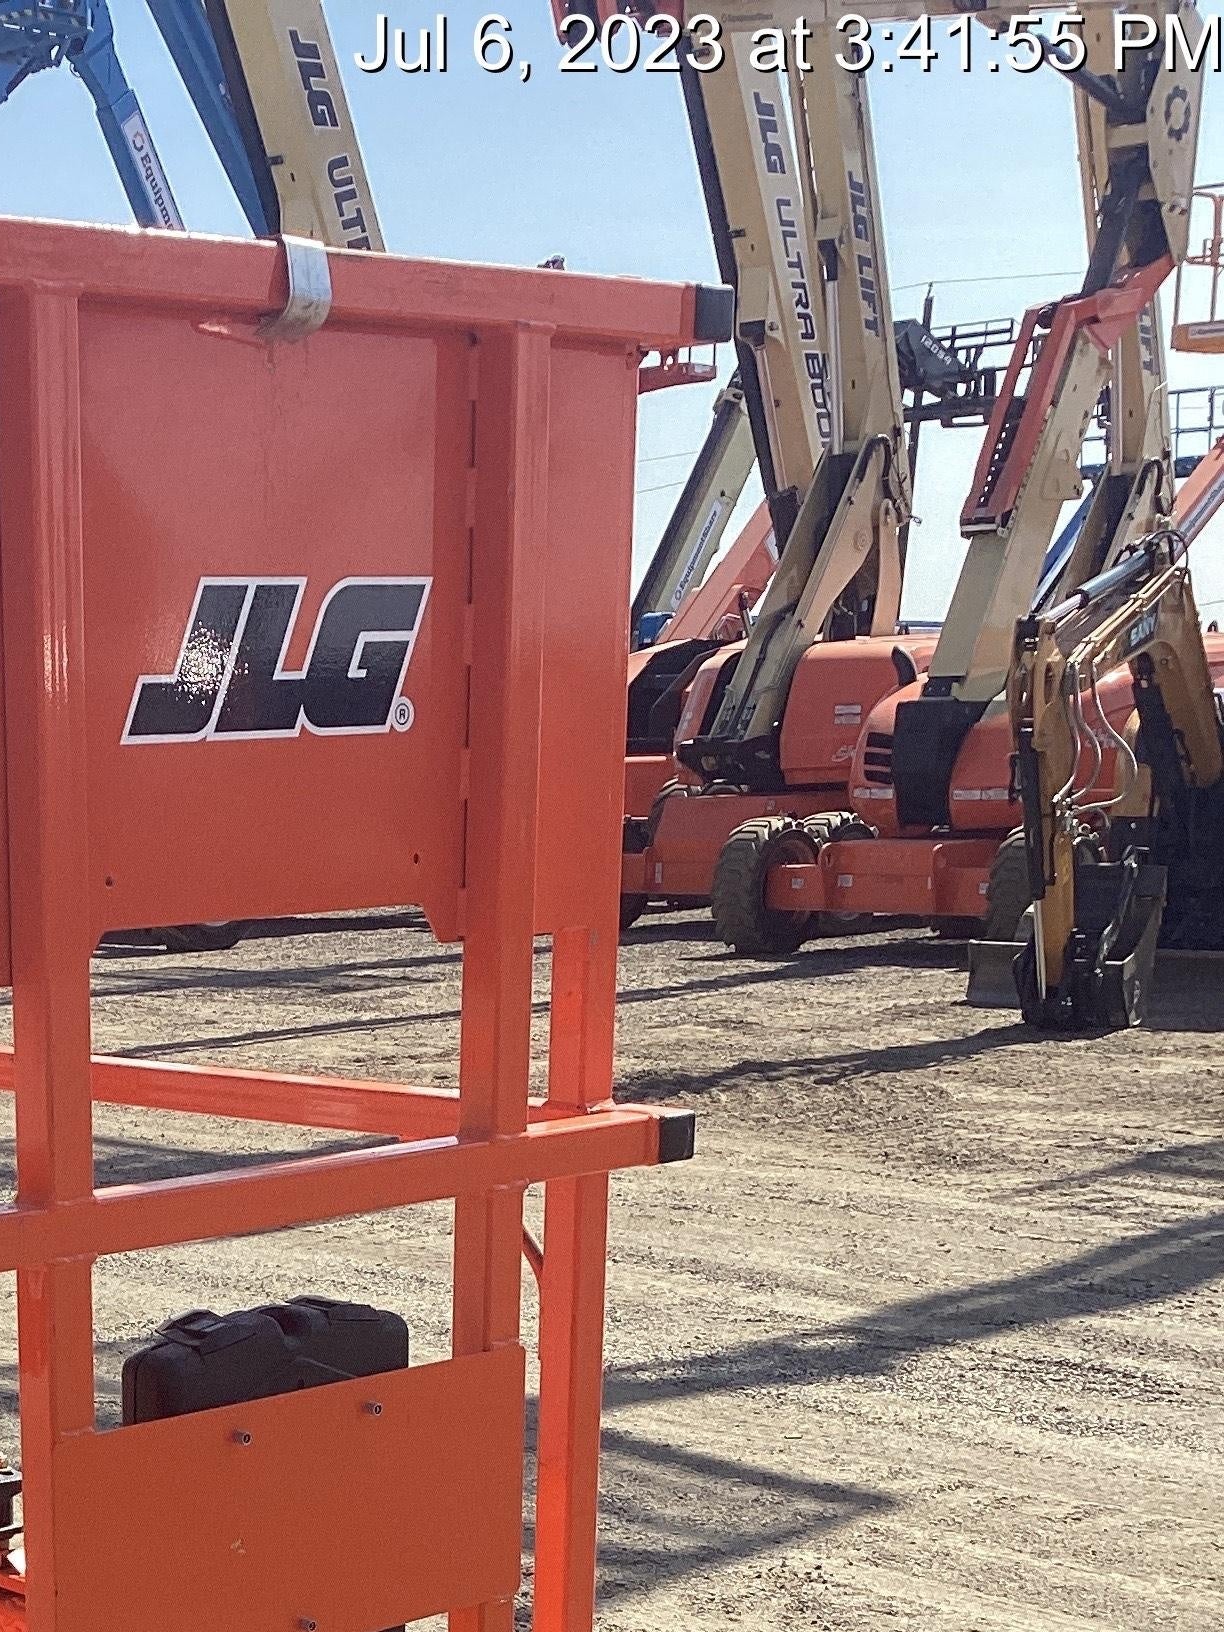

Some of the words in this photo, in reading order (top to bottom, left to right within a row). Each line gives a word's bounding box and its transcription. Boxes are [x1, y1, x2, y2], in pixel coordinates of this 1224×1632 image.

[288, 27, 342, 130] JLG
[751, 90, 787, 176] JLG
[775, 197, 818, 343] ULTRA
[803, 350, 833, 450] BOO
[847, 170, 870, 243] JLG
[120, 576, 433, 745] JLG
